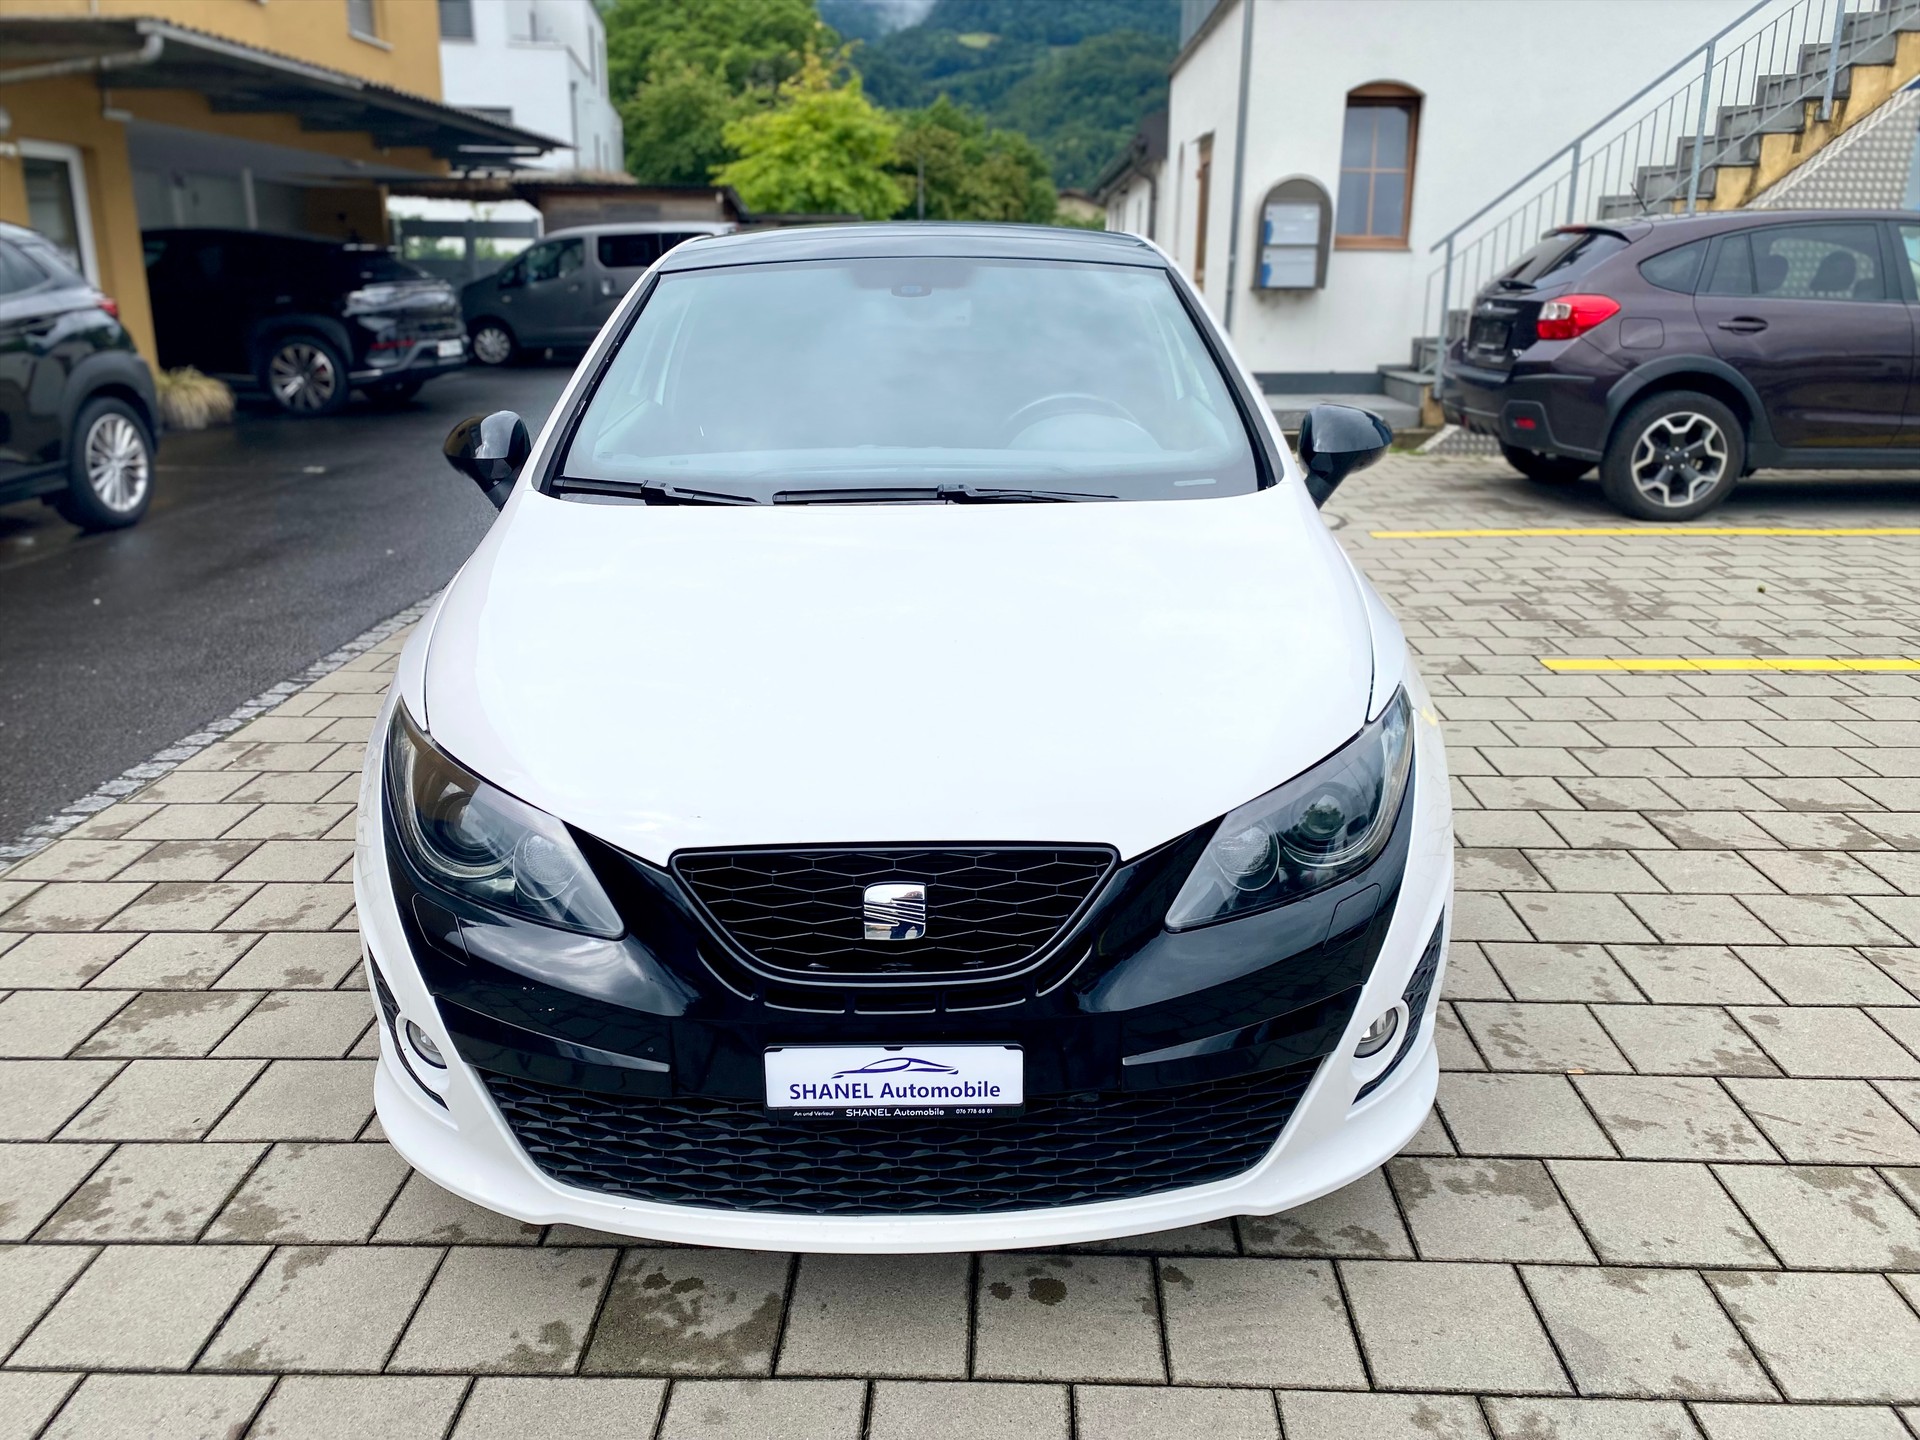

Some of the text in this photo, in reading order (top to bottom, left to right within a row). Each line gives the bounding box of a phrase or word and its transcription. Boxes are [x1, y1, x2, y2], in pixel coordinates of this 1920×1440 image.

[789, 1081, 1000, 1099] SHANEL Automobile
[845, 1108, 892, 1117] SHANEL
[893, 1108, 945, 1117] Automobile
